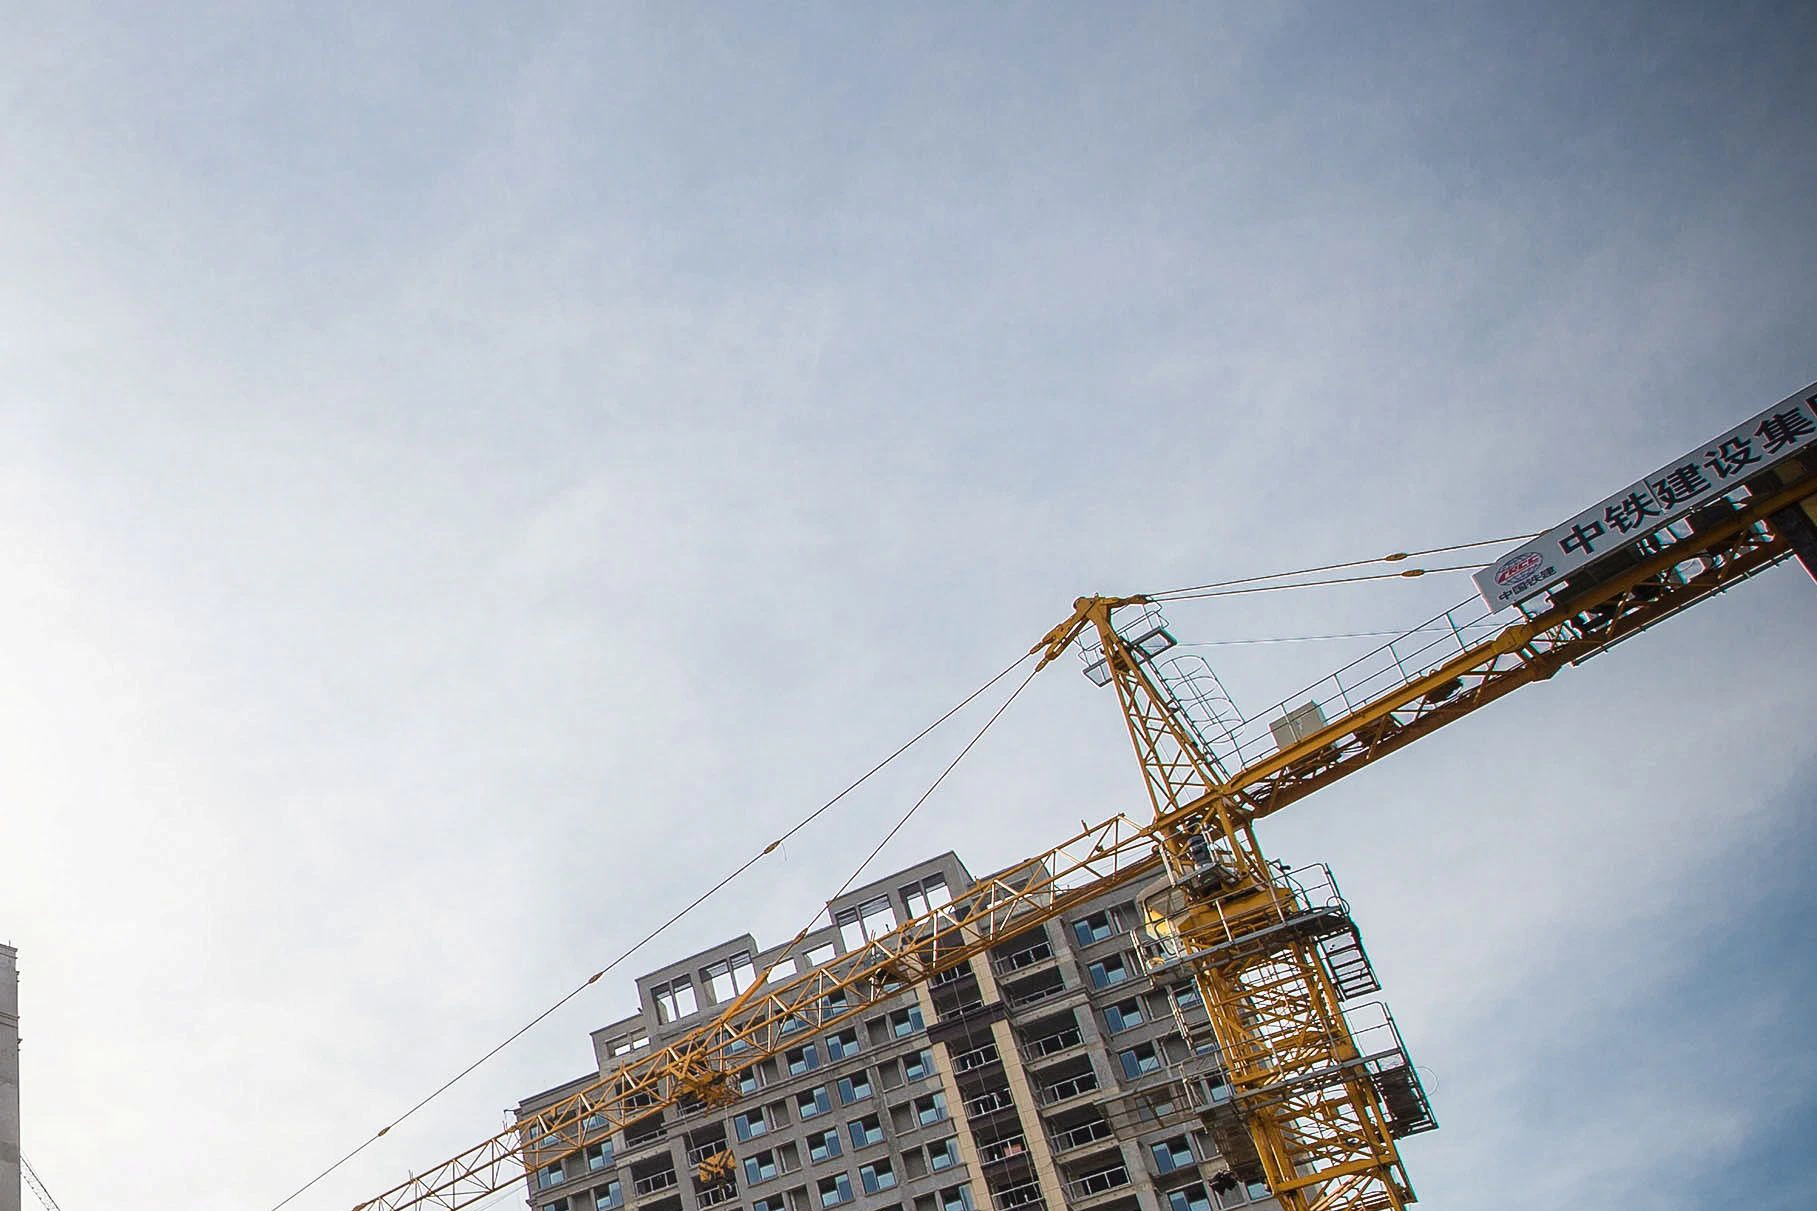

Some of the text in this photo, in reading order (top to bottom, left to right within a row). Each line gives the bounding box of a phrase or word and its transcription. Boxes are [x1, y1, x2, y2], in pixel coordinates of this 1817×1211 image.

[1558, 394, 1817, 556] 中铁建设集
[1498, 566, 1557, 600] 中国铁建
